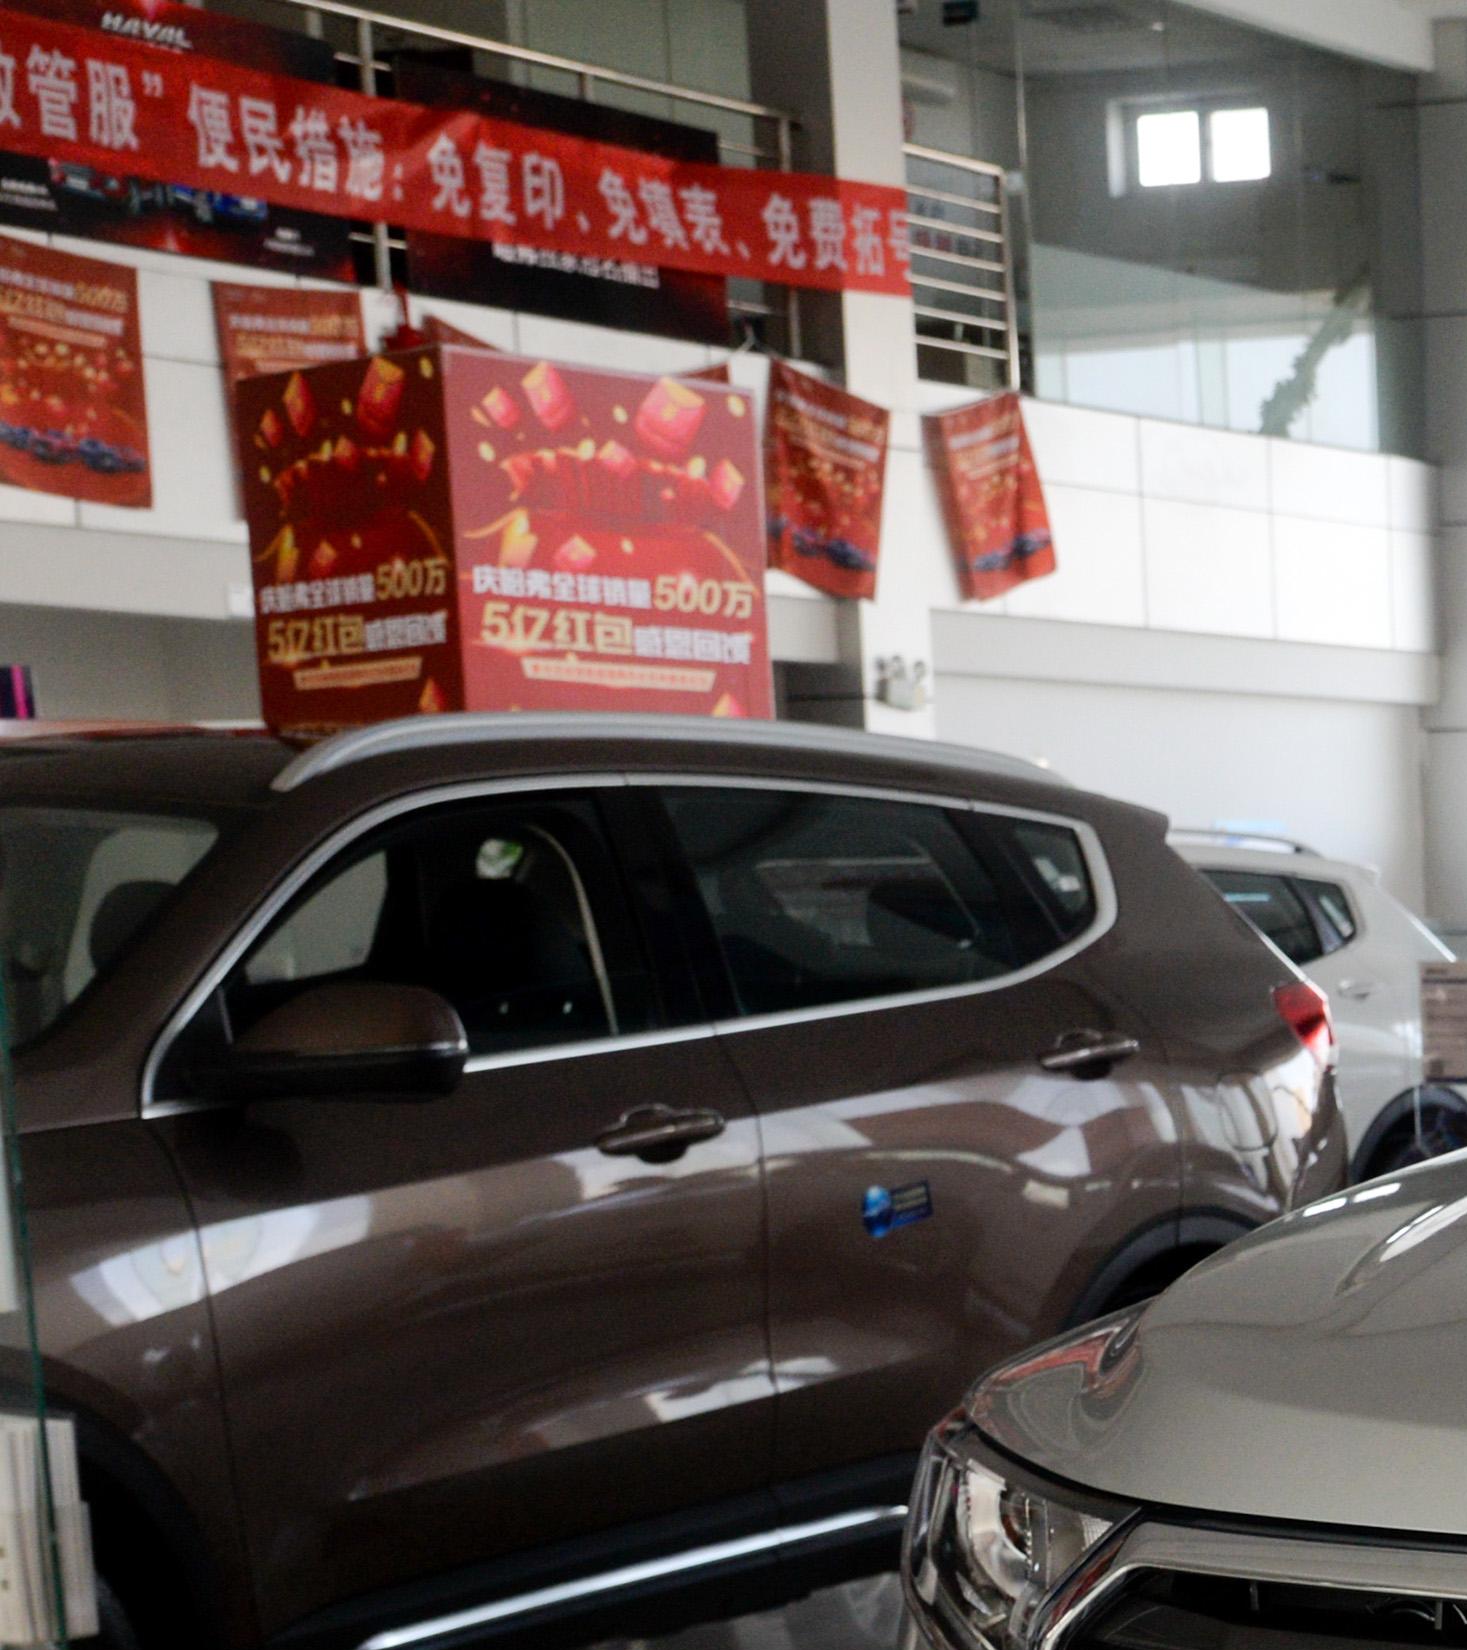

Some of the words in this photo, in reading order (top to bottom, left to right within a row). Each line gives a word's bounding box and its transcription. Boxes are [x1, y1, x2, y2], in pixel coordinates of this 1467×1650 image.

[102, 11, 193, 50] HAVAL
[471, 563, 755, 619] 庆哈弗全球销量500万
[480, 601, 754, 665] 5亿红包感恩回馈
